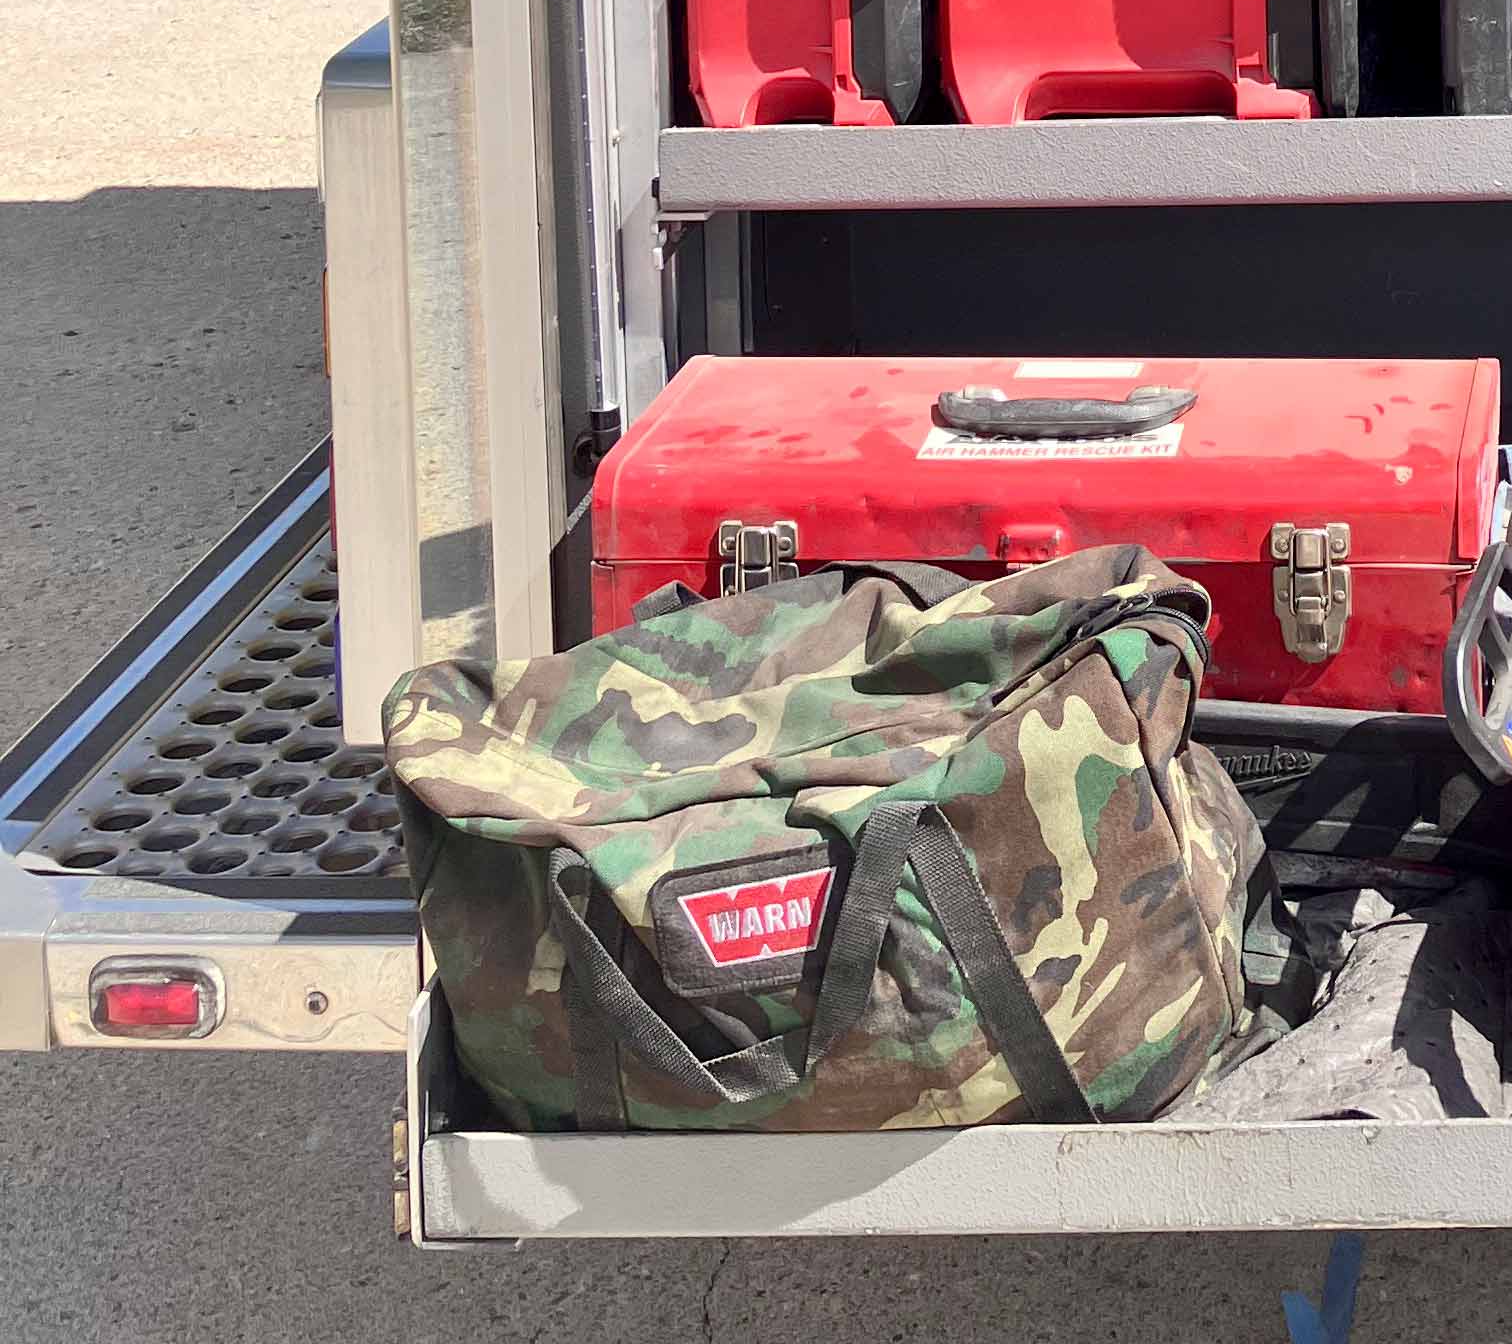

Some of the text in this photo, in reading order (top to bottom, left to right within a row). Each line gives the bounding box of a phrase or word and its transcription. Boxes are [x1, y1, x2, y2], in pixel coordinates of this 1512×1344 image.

[922, 444, 1171, 457] AIR HAMMER RESCUE KIT
[708, 897, 812, 944] WARN
